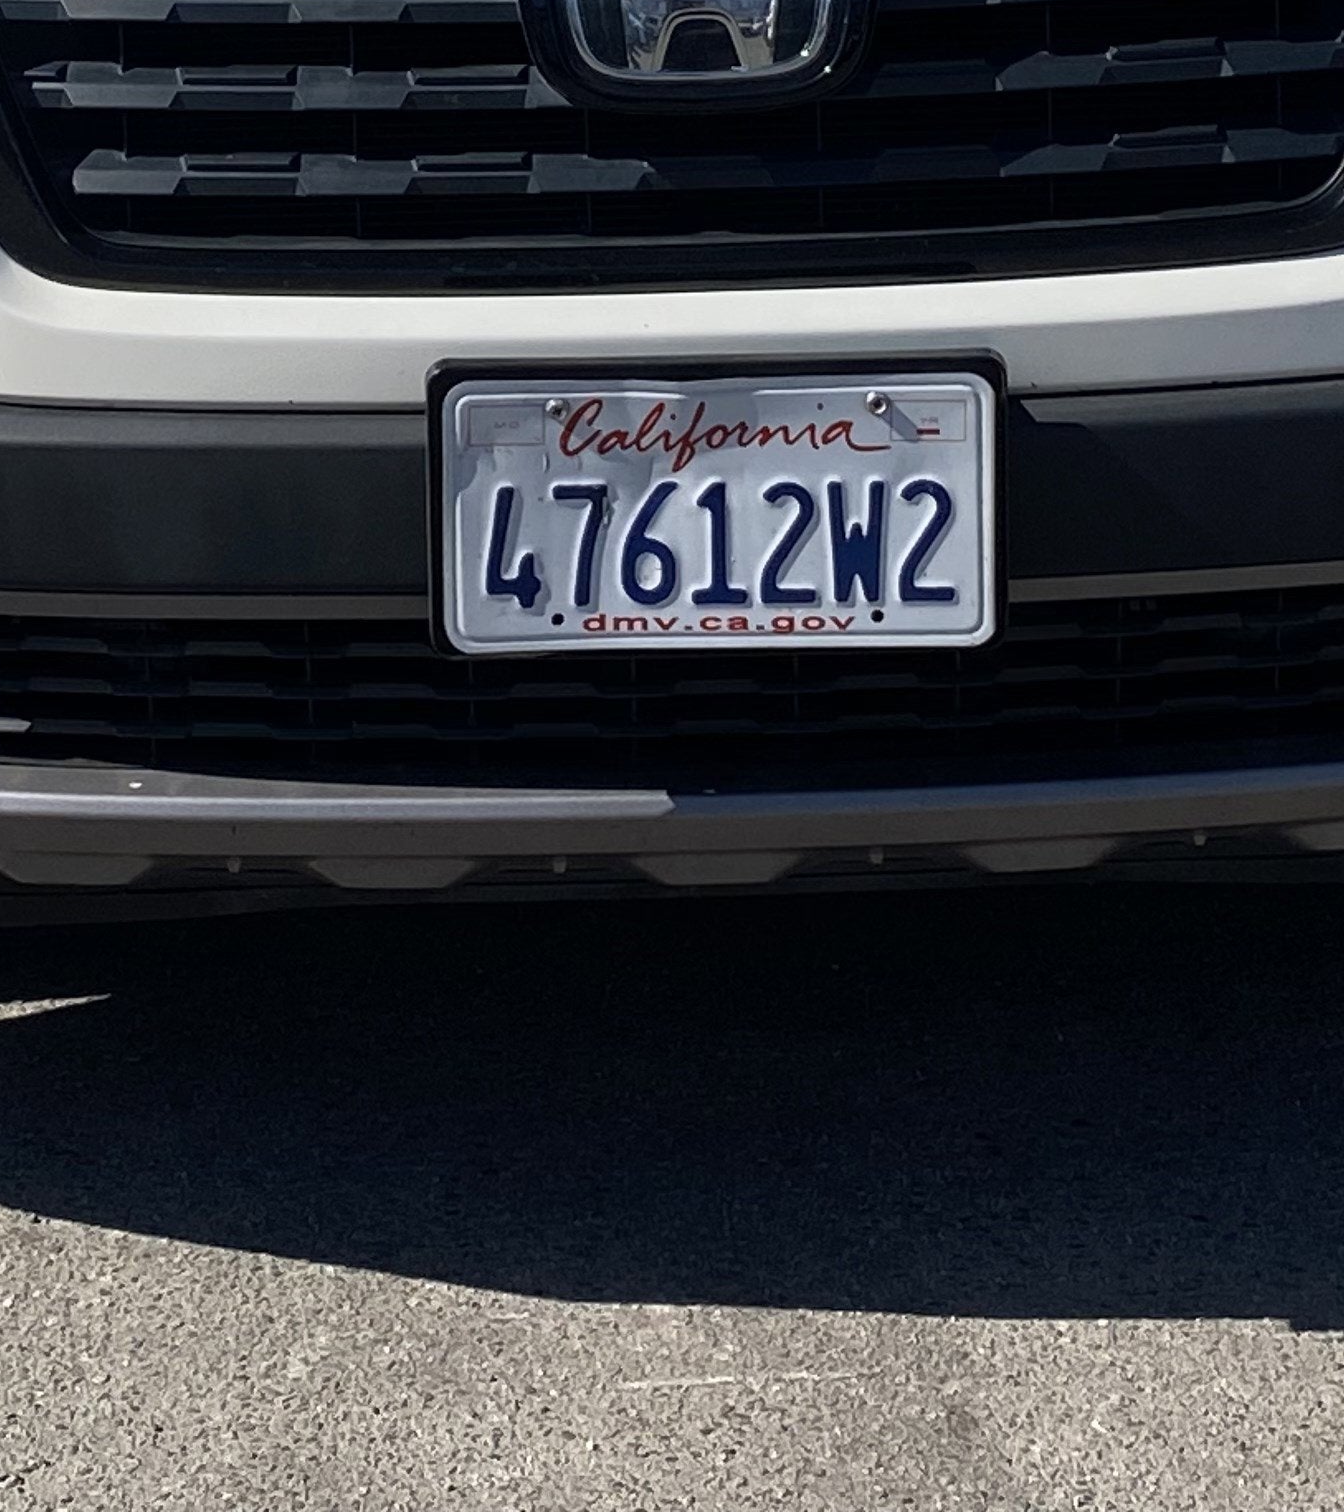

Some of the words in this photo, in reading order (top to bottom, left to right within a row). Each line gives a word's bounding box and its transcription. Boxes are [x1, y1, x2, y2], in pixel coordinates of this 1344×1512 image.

[559, 397, 892, 473] California
[485, 478, 957, 609] 47612W2
[582, 612, 855, 633] dmv.ca.gov
